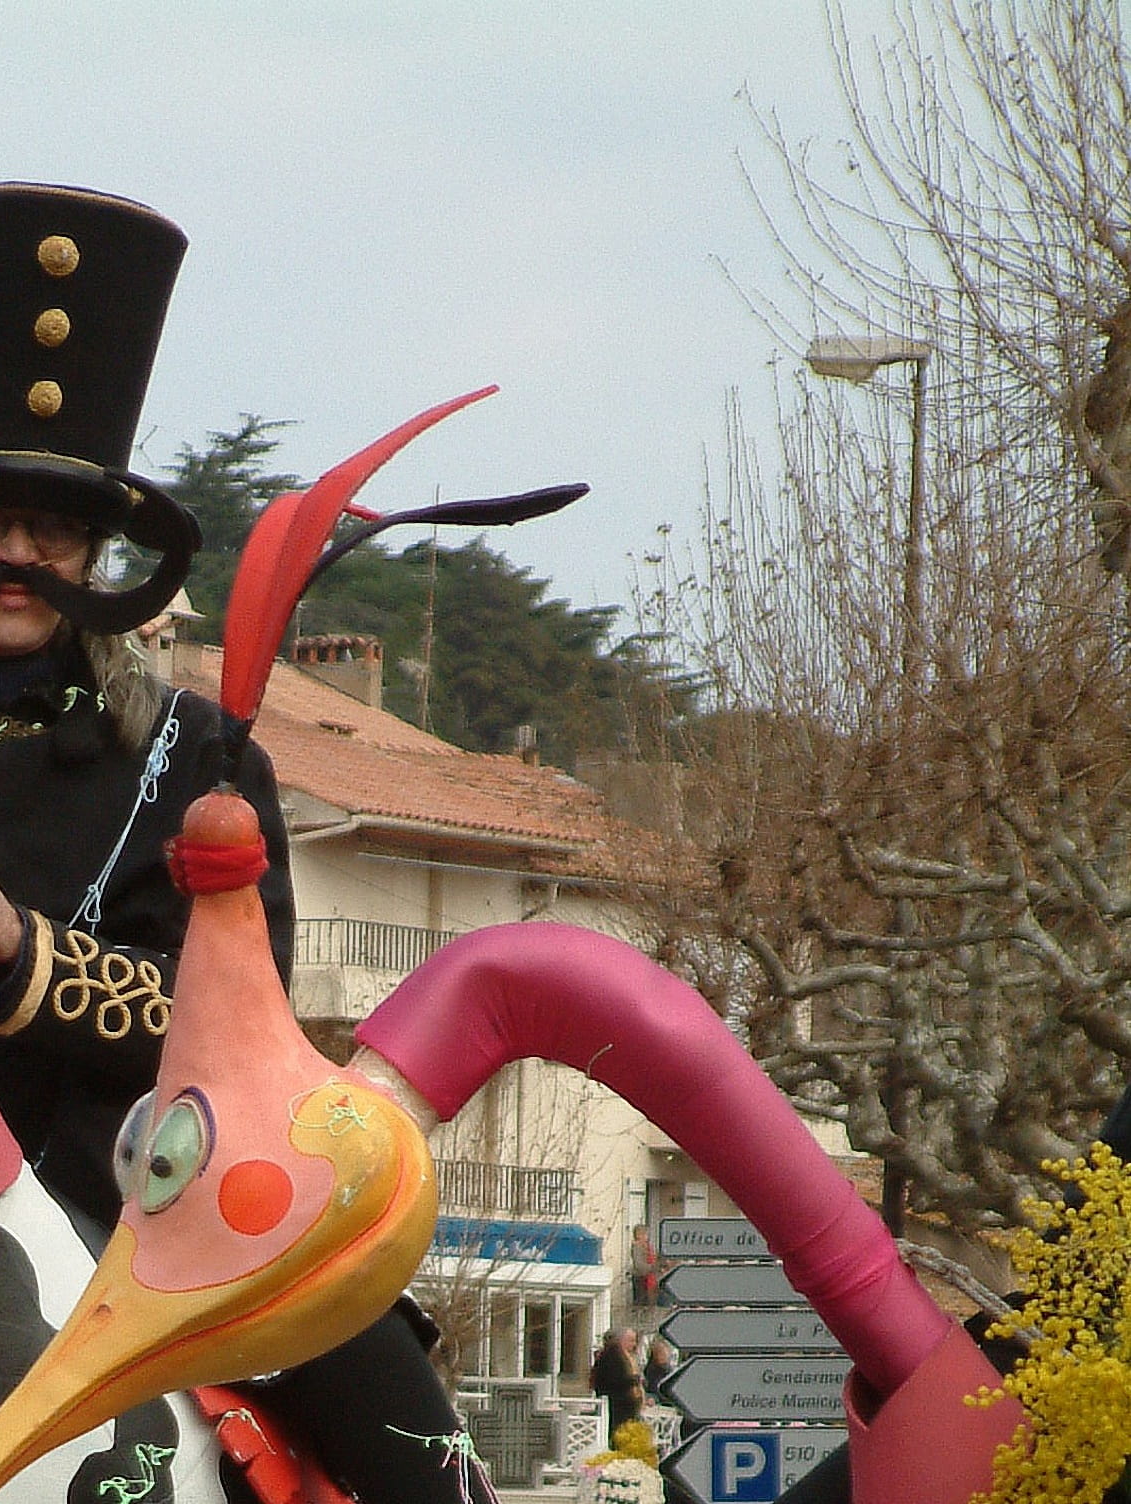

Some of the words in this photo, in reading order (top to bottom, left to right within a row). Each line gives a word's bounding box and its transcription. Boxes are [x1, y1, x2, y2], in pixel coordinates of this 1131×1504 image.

[669, 1229, 723, 1247] Office
[737, 1230, 757, 1246] de
[775, 1322, 798, 1338] La
[762, 1368, 844, 1385] Gendarme
[730, 1393, 777, 1409] Police
[784, 1445, 816, 1461] 510
[724, 1441, 767, 1495] P
